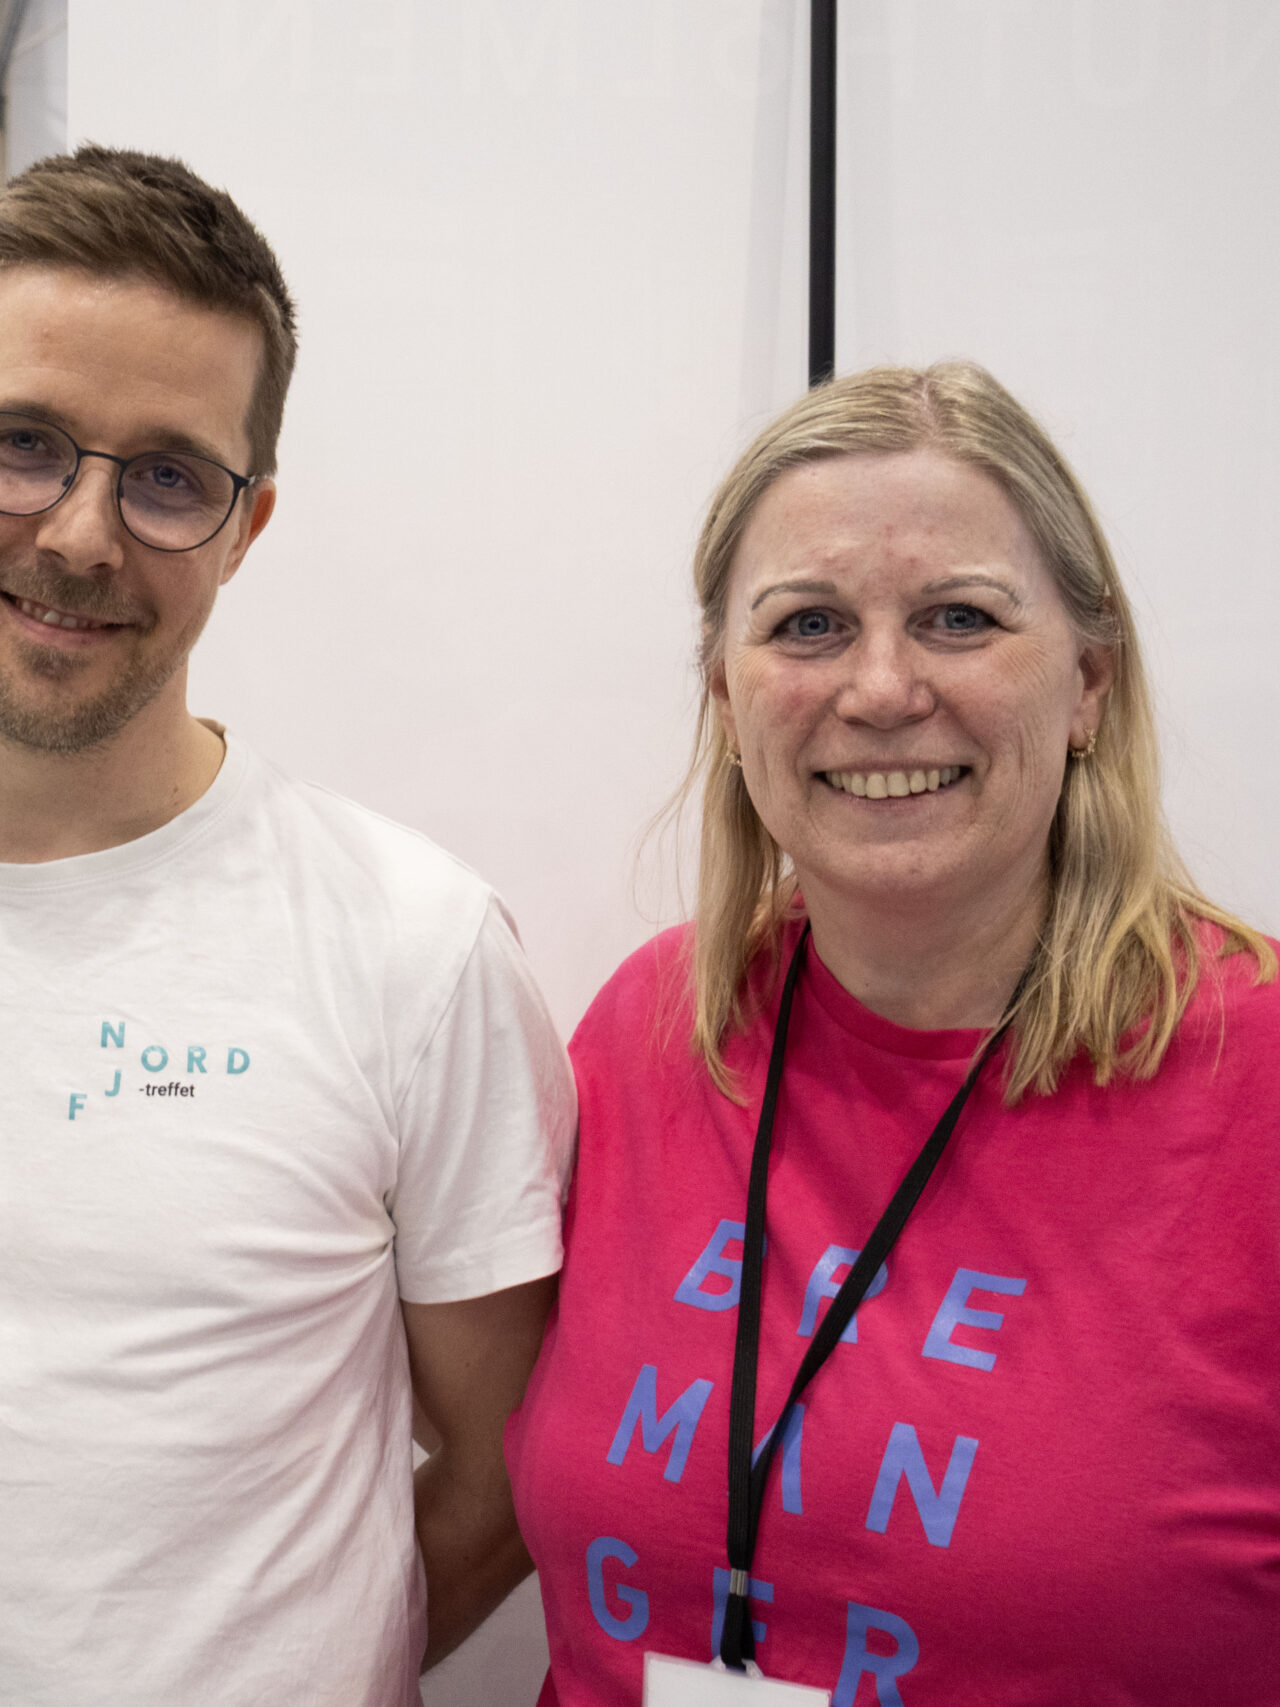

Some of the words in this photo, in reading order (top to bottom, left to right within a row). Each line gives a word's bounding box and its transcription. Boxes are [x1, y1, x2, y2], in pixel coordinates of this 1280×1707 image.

[100, 1021, 251, 1075] NORD
[138, 1082, 196, 1098] -treffet
[673, 1218, 1028, 1372] BRE
